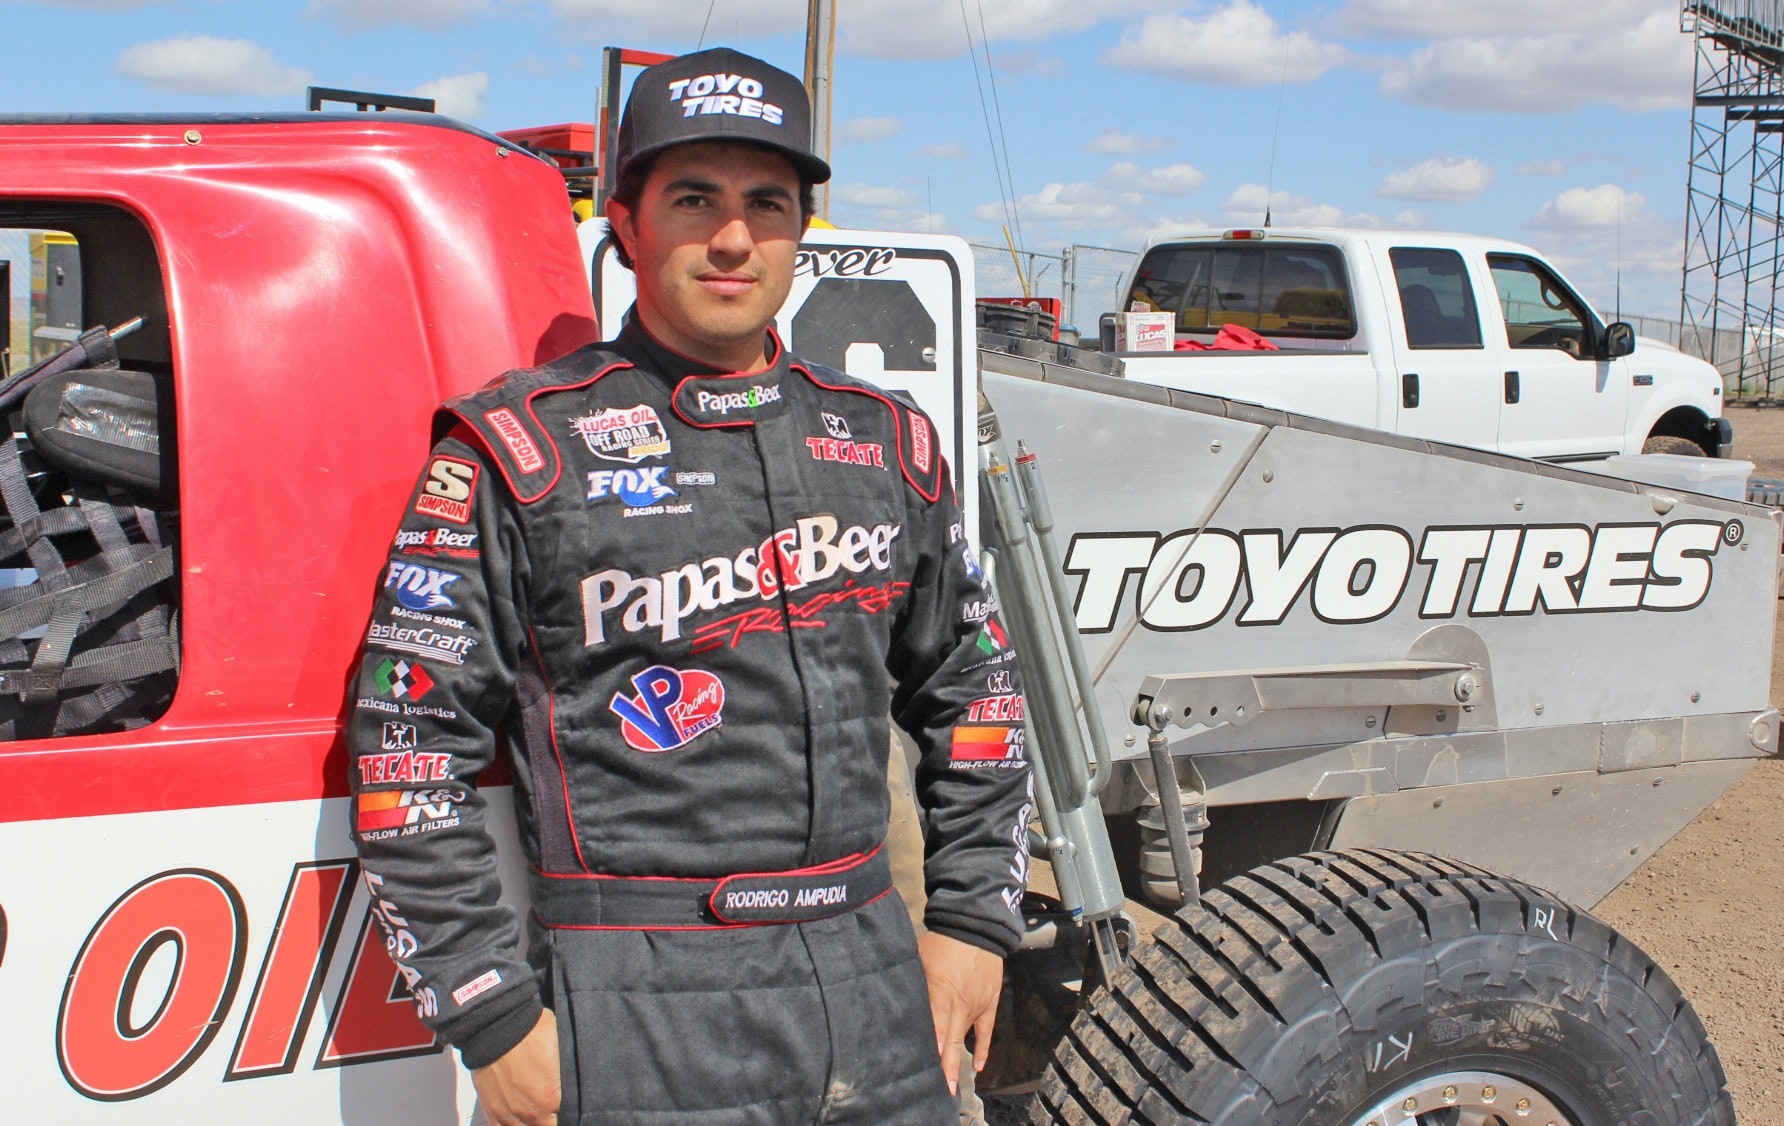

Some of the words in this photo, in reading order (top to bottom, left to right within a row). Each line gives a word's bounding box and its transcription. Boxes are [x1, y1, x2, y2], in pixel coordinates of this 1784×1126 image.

[668, 73, 763, 101] TOYO
[682, 95, 784, 125] TIRES
[1135, 329, 1167, 342] LUCAS
[583, 414, 626, 432] LUCAS
[630, 409, 654, 425] OIL
[492, 411, 539, 471] SIMPSON
[589, 432, 611, 447] OFF
[613, 425, 651, 442] ROAD
[601, 440, 634, 452] RACING
[910, 414, 929, 469] SIMPSON
[806, 436, 885, 468] TECATE
[586, 466, 670, 501] FOX
[417, 494, 467, 519] SIMPSON
[623, 505, 664, 518] RACING
[665, 503, 694, 515] SHOX
[384, 561, 461, 597] FOX
[1063, 525, 1412, 633] TOYO
[1416, 521, 1726, 619] TIRES
[390, 606, 433, 621] RACING
[433, 615, 467, 630] SHOX
[367, 619, 474, 656] asterCraft
[402, 702, 457, 719] logistics
[608, 665, 684, 750] VP
[672, 679, 719, 727] Racing
[683, 712, 720, 738] FUELS
[358, 750, 453, 785] TECATE
[949, 760, 999, 770] HIGH-FLOW
[397, 788, 466, 825] K&N
[402, 826, 419, 838] AIR
[421, 817, 460, 833] FILTERS
[725, 889, 789, 908] RODRIGO
[794, 884, 848, 907] AMPUDIA
[459, 976, 495, 1000] SIMPSON
